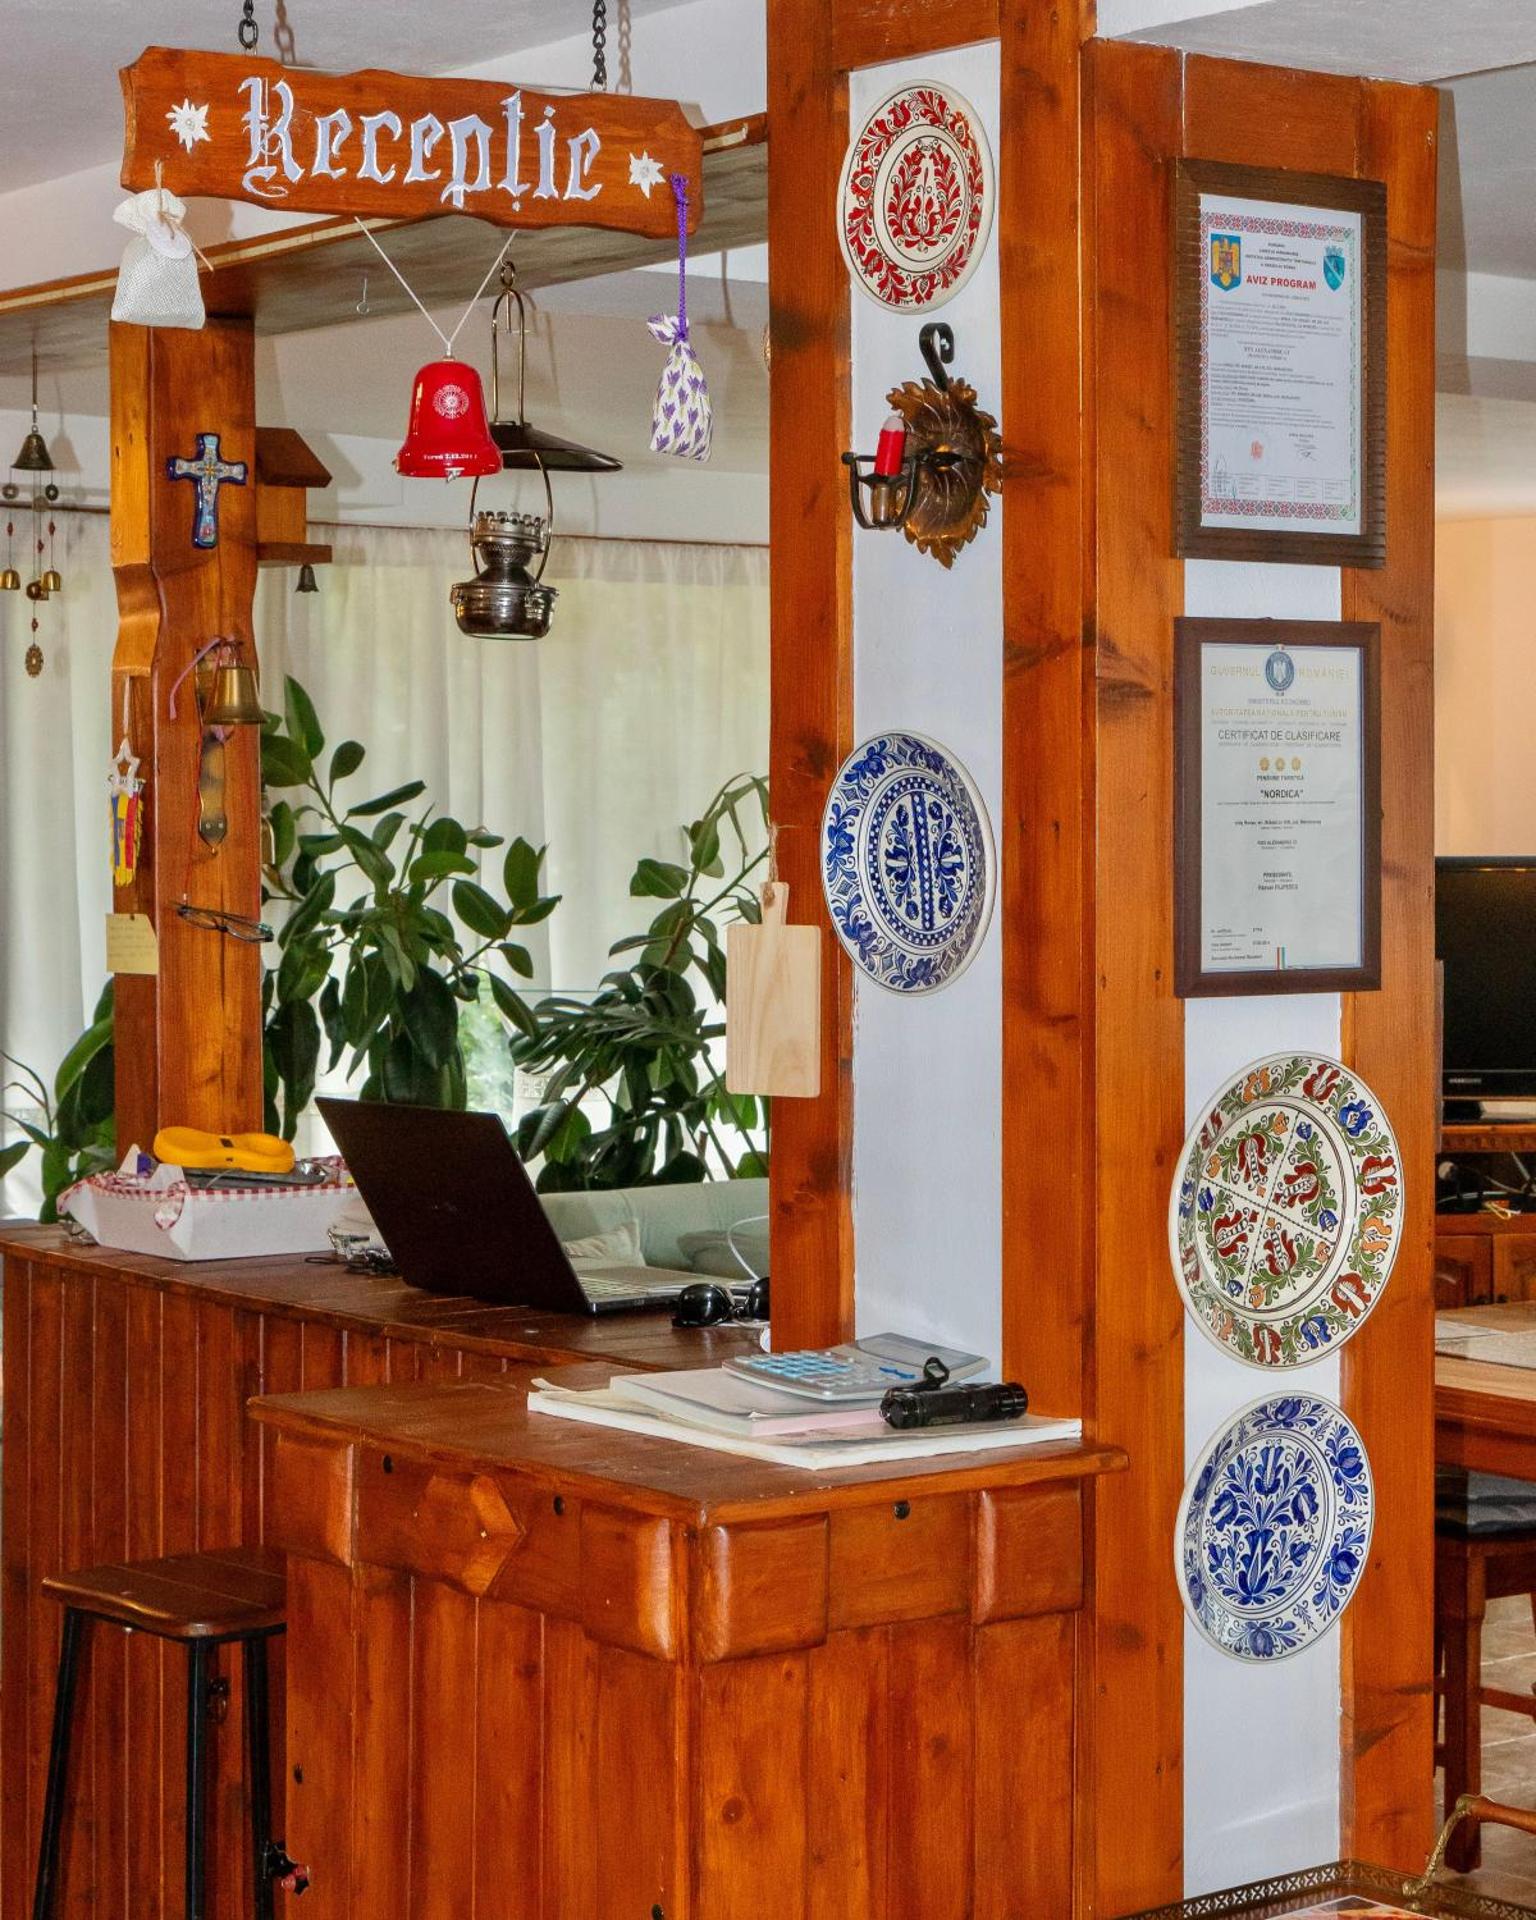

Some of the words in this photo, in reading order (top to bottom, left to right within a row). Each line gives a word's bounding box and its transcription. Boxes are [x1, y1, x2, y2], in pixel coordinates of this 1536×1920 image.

[1246, 275, 1268, 286] AVIZ
[1270, 277, 1317, 290] PROGRAM
[1218, 729, 1268, 741] CERTIFICAT
[1270, 730, 1283, 741] DE
[1285, 730, 1342, 742] CLASIFICARE
